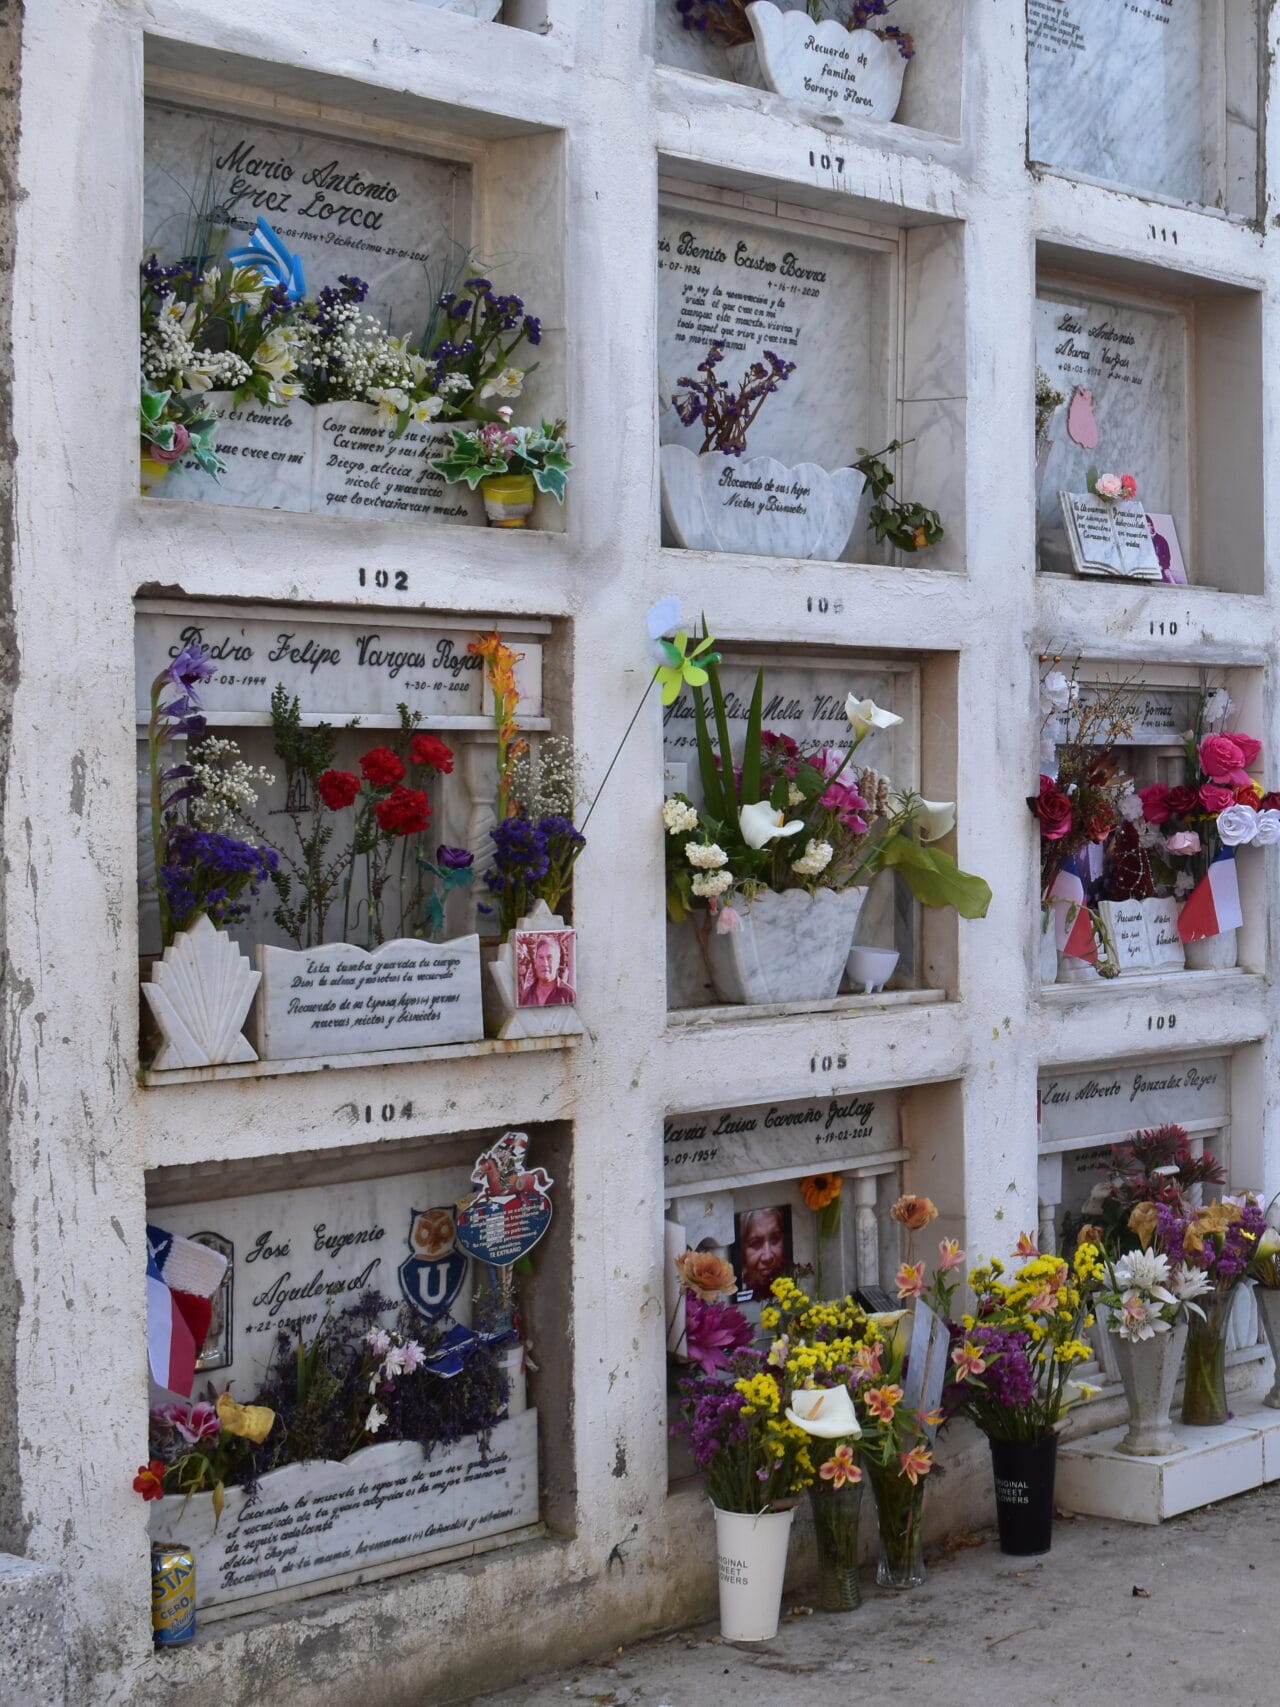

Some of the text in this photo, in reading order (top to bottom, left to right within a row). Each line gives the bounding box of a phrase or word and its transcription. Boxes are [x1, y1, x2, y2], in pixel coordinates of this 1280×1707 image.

[804, 35, 850, 60] Recuerdo
[821, 63, 856, 82] familia
[803, 76, 838, 101] Cornejo
[216, 140, 399, 203] Mario Antonio
[809, 151, 845, 173] 107
[298, 191, 383, 230] Lorca
[1149, 224, 1178, 245] 111
[677, 231, 827, 283] Benito Castro Barra
[1088, 322, 1135, 345] Antonio
[323, 417, 346, 432] Con
[350, 425, 385, 438] amor
[333, 433, 385, 452] Carmen
[718, 466, 763, 490] Recuerdo
[764, 478, 775, 492] de
[790, 481, 811, 500] hijos
[326, 492, 348, 506] que
[433, 505, 469, 518] mucho
[358, 567, 409, 591] 102
[1149, 620, 1178, 636] 110
[268, 633, 341, 674] Felipe
[356, 634, 426, 678] Vargas
[336, 960, 372, 972] tumba
[373, 959, 416, 975] guarda
[419, 957, 430, 967] tu
[290, 976, 314, 988] Dios
[287, 997, 337, 1015] Recuerdo
[339, 998, 351, 1012] de
[385, 1015, 395, 1029] y
[1147, 1014, 1177, 1032] 109
[809, 1053, 848, 1074] 105
[1041, 1067, 1218, 1105] Luis Alberto Gonzalez Reyes
[364, 1101, 414, 1124] 104
[711, 1112, 758, 1136] Luisa
[245, 1223, 387, 1263] José Eugenio
[417, 1263, 451, 1305] U
[227, 1526, 240, 1540] el
[242, 1515, 294, 1536] recuerdo
[297, 1511, 311, 1523] de
[315, 1507, 329, 1519] tu
[417, 1482, 429, 1495] la
[463, 1466, 507, 1483] manera
[238, 1497, 289, 1523] Cuando
[312, 1486, 355, 1505] muerte
[412, 1470, 425, 1482] de
[429, 1468, 443, 1478] un
[220, 1564, 277, 1590] Recuerdo
[281, 1561, 295, 1574] de
[468, 1517, 479, 1532] y
[225, 1540, 240, 1554] de
